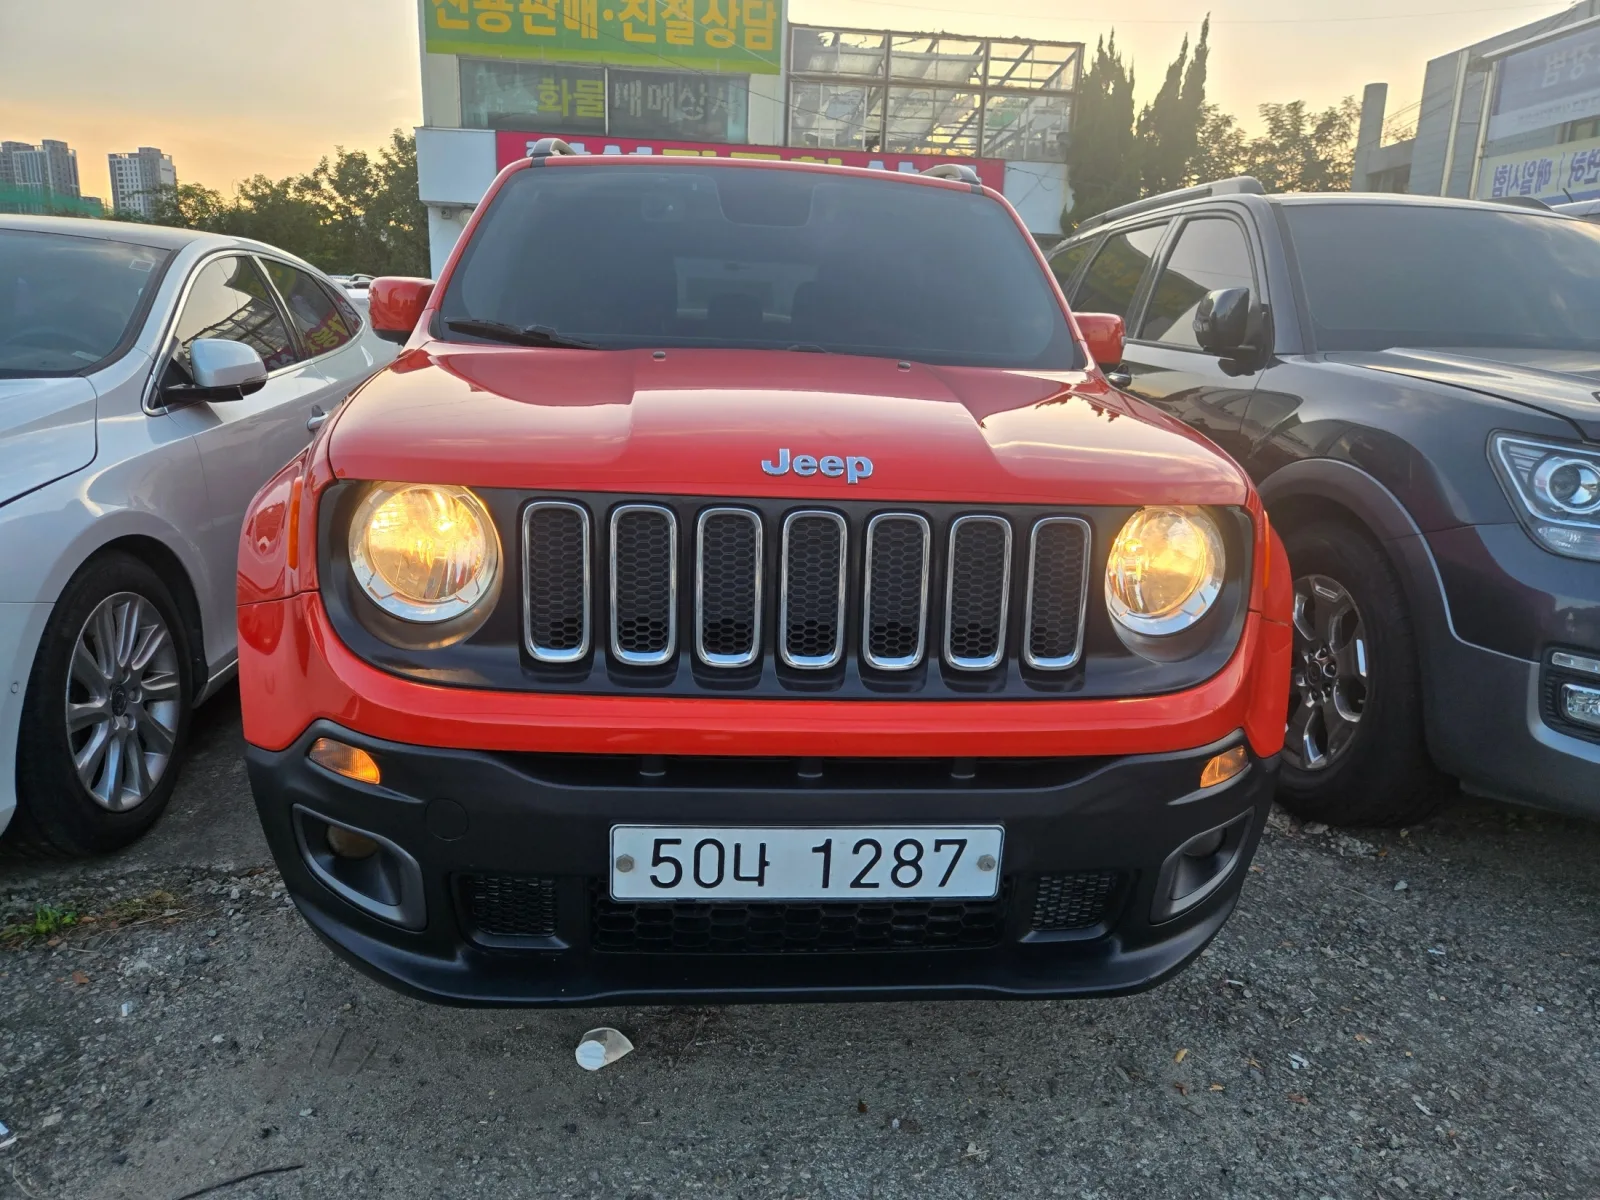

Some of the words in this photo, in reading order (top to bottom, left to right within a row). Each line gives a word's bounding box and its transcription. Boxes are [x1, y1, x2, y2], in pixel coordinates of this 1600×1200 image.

[537, 78, 605, 117] 화물
[761, 448, 873, 484] Jeep
[649, 838, 770, 889] 50나
[812, 838, 968, 889] 1287
